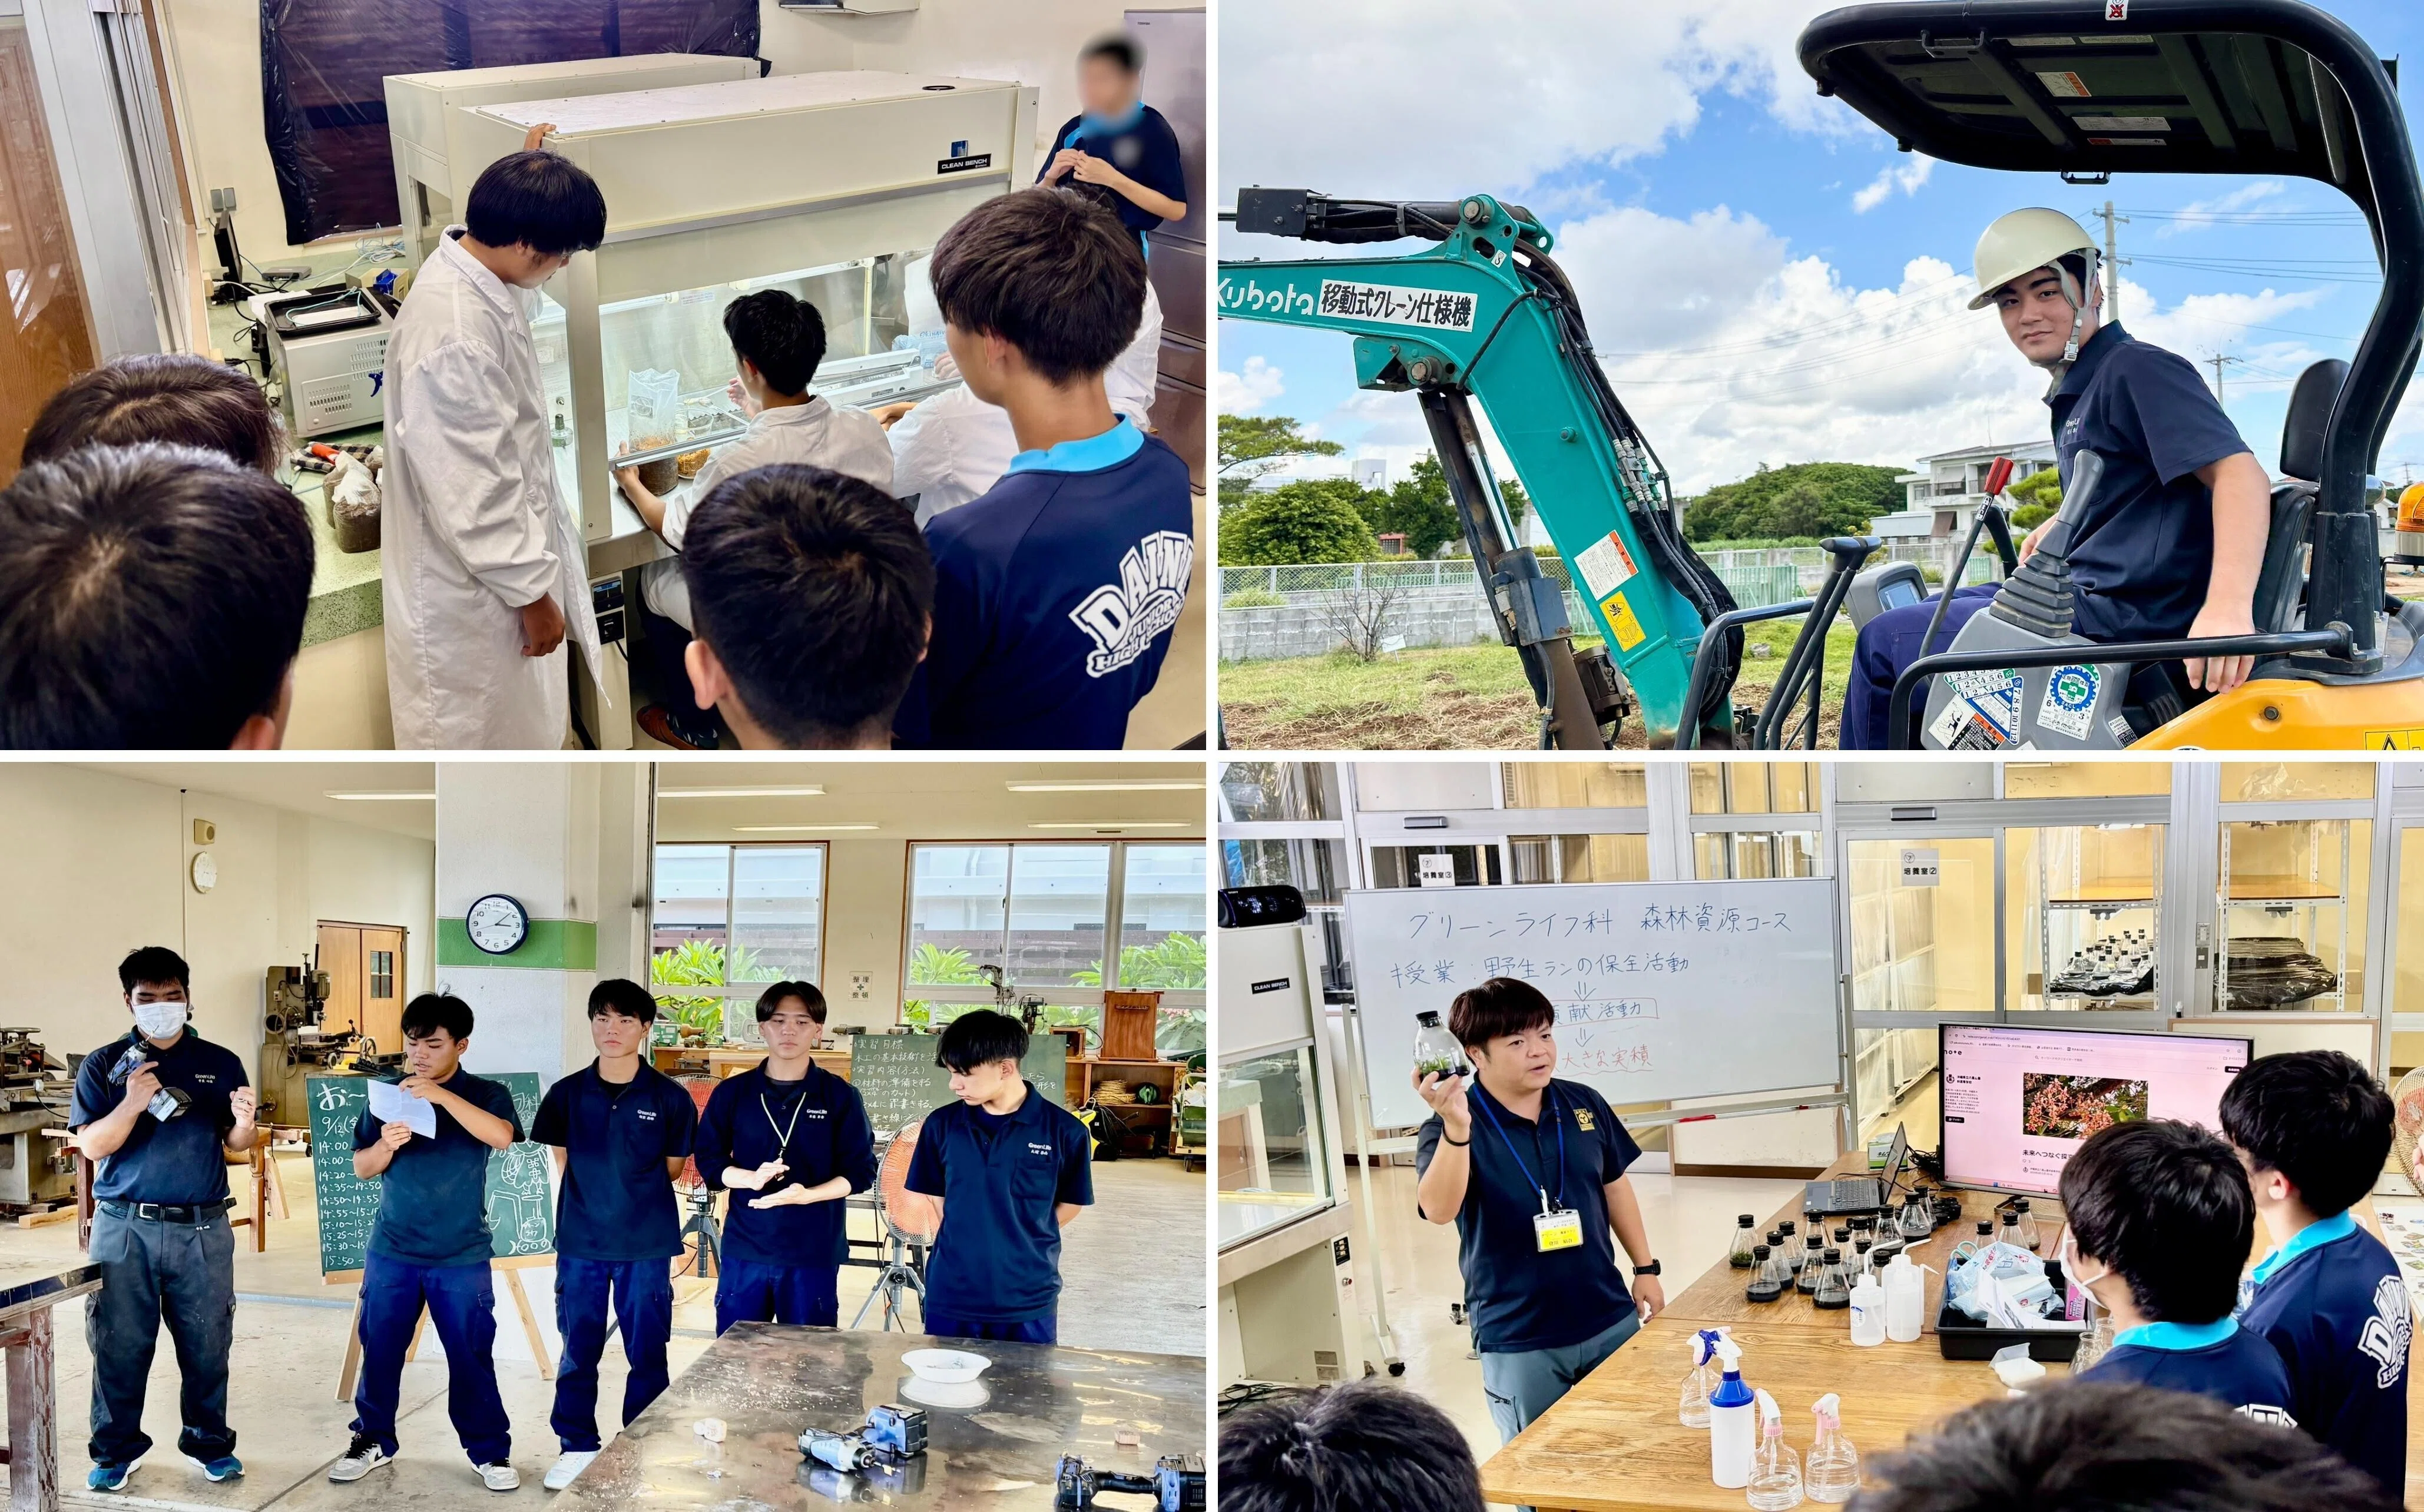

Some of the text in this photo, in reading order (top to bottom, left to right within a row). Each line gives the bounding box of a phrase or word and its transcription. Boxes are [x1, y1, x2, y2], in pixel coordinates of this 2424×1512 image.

[942, 158, 987, 170] CLEAN BENCH
[1321, 283, 1471, 327] 移動式クレーン仕様機
[1410, 903, 1791, 939] グリーンライフ科 森林資源コース
[319, 1140, 348, 1154] 14:00
